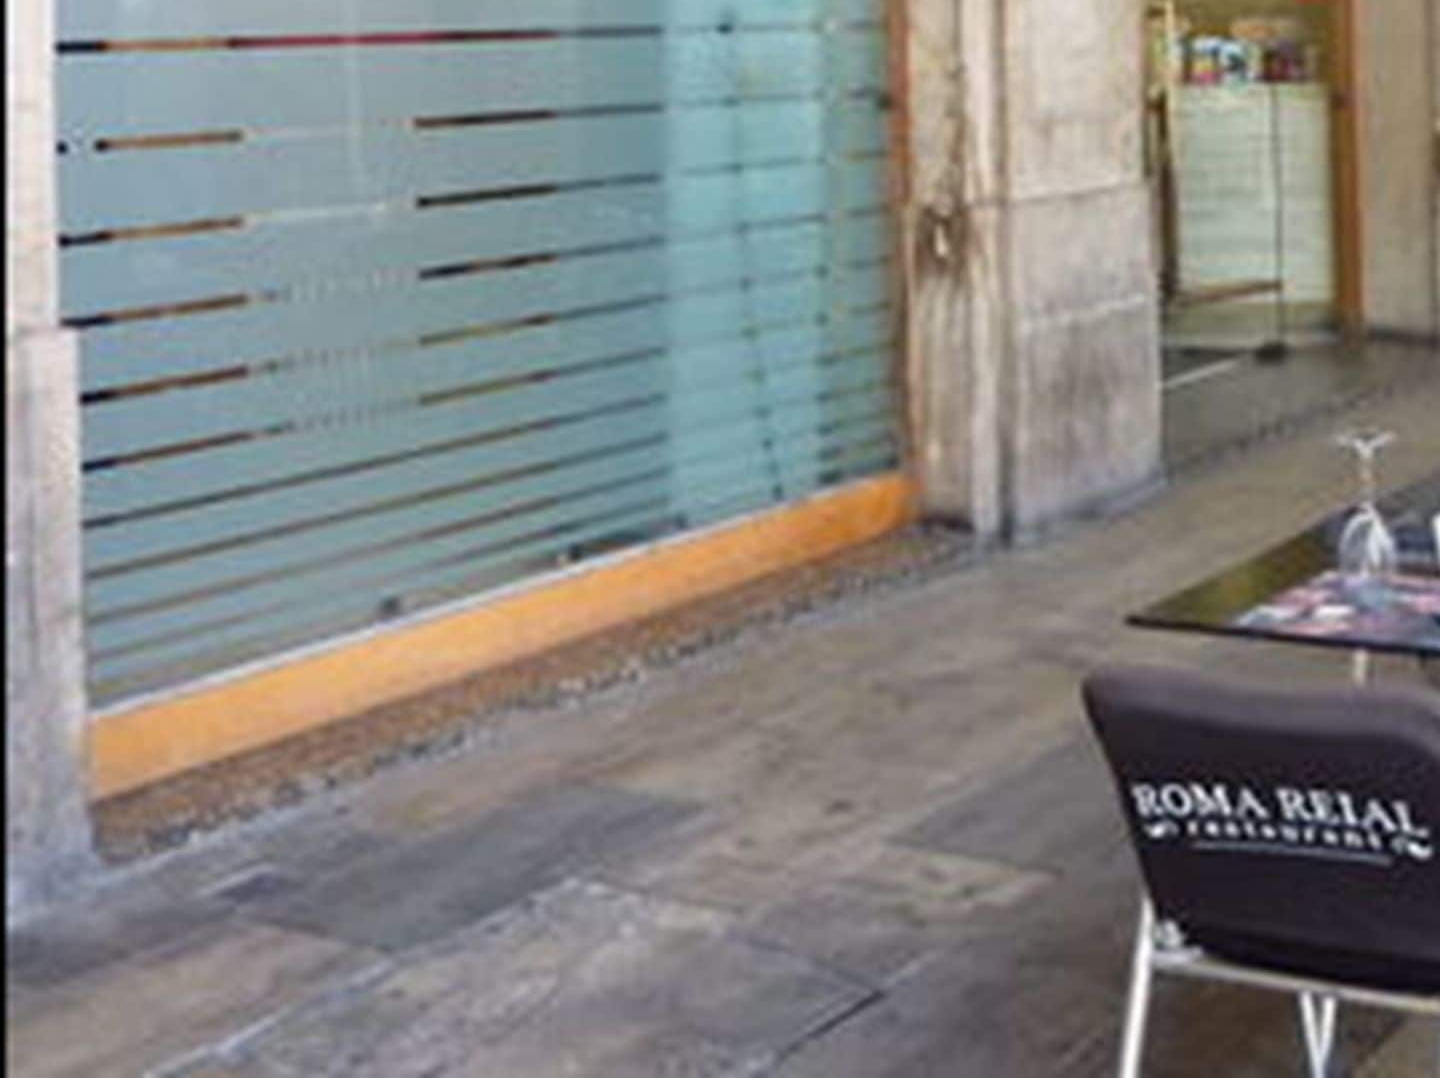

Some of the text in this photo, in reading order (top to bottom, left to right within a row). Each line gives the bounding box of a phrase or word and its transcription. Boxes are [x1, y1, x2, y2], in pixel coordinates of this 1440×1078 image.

[1130, 781, 1431, 839] ROMA REIAL
[1186, 820, 1383, 851] restaurant
